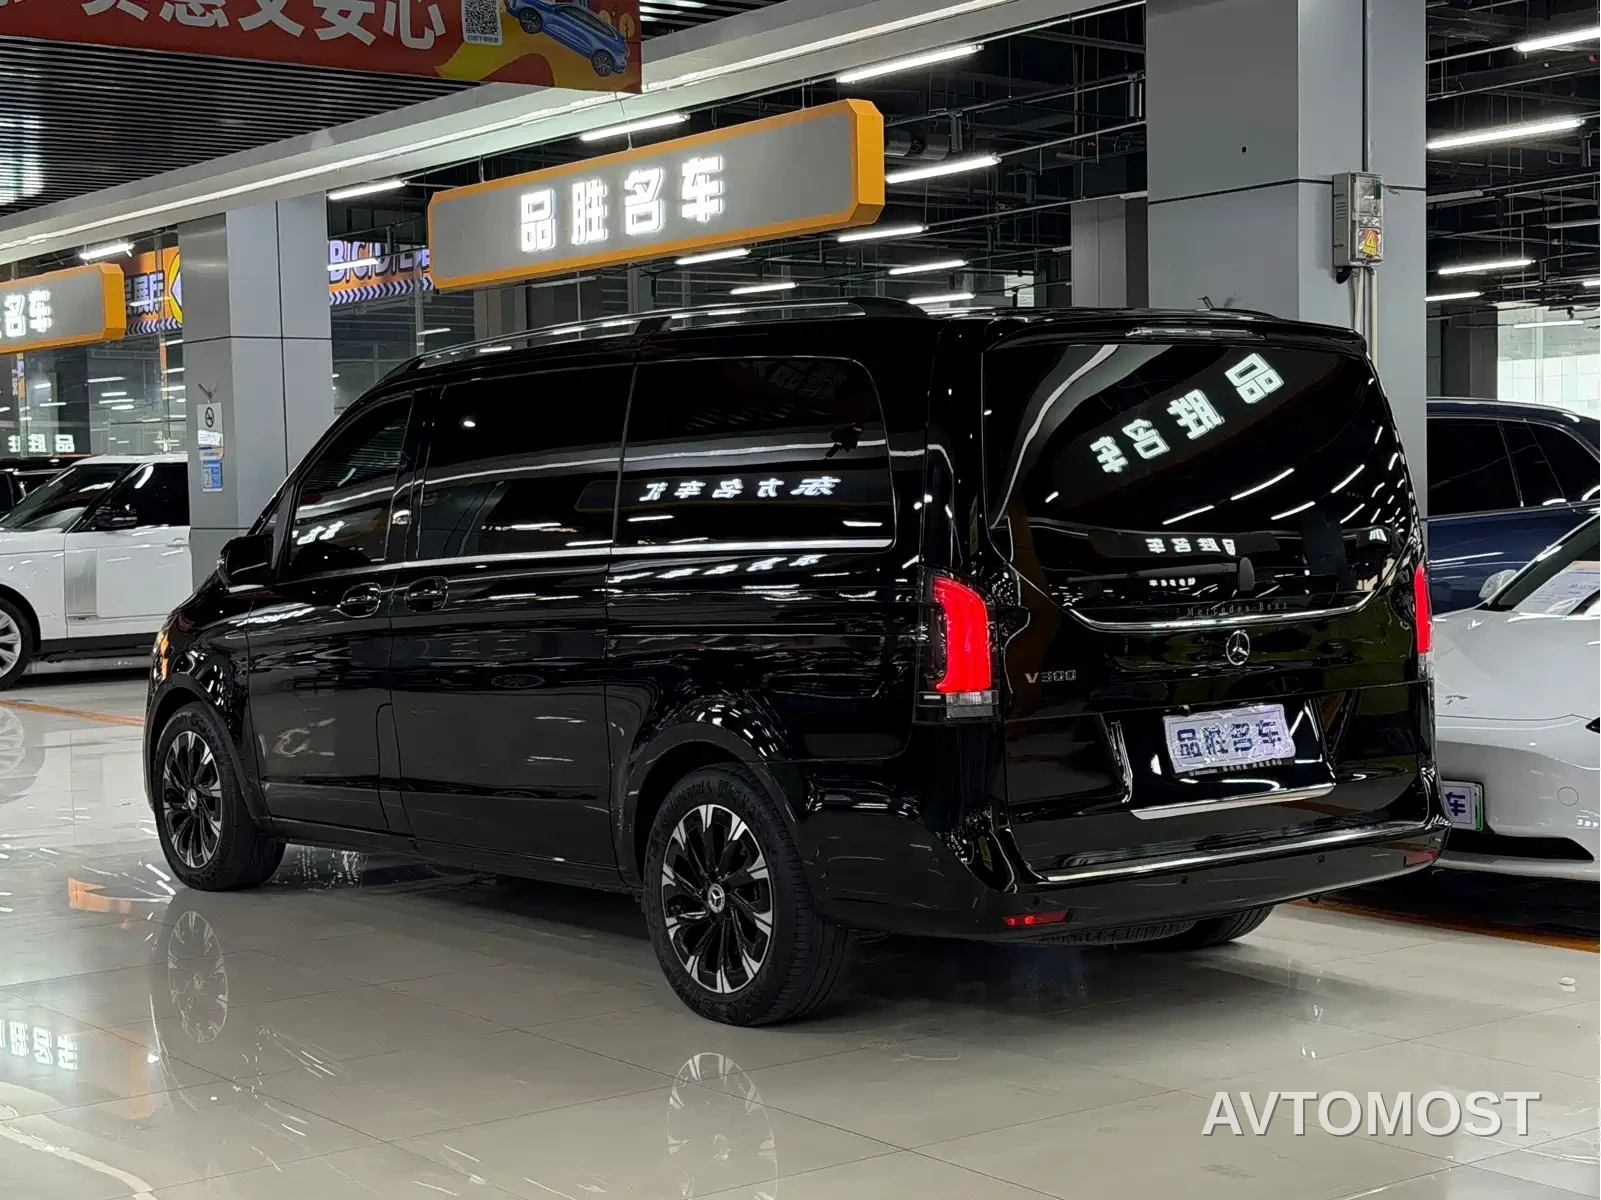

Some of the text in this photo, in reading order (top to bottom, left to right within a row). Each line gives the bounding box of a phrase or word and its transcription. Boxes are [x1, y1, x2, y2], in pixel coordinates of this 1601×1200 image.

[521, 155, 723, 252] 品胜名车
[1024, 669, 1077, 684] V300
[1445, 791, 1466, 817] 车
